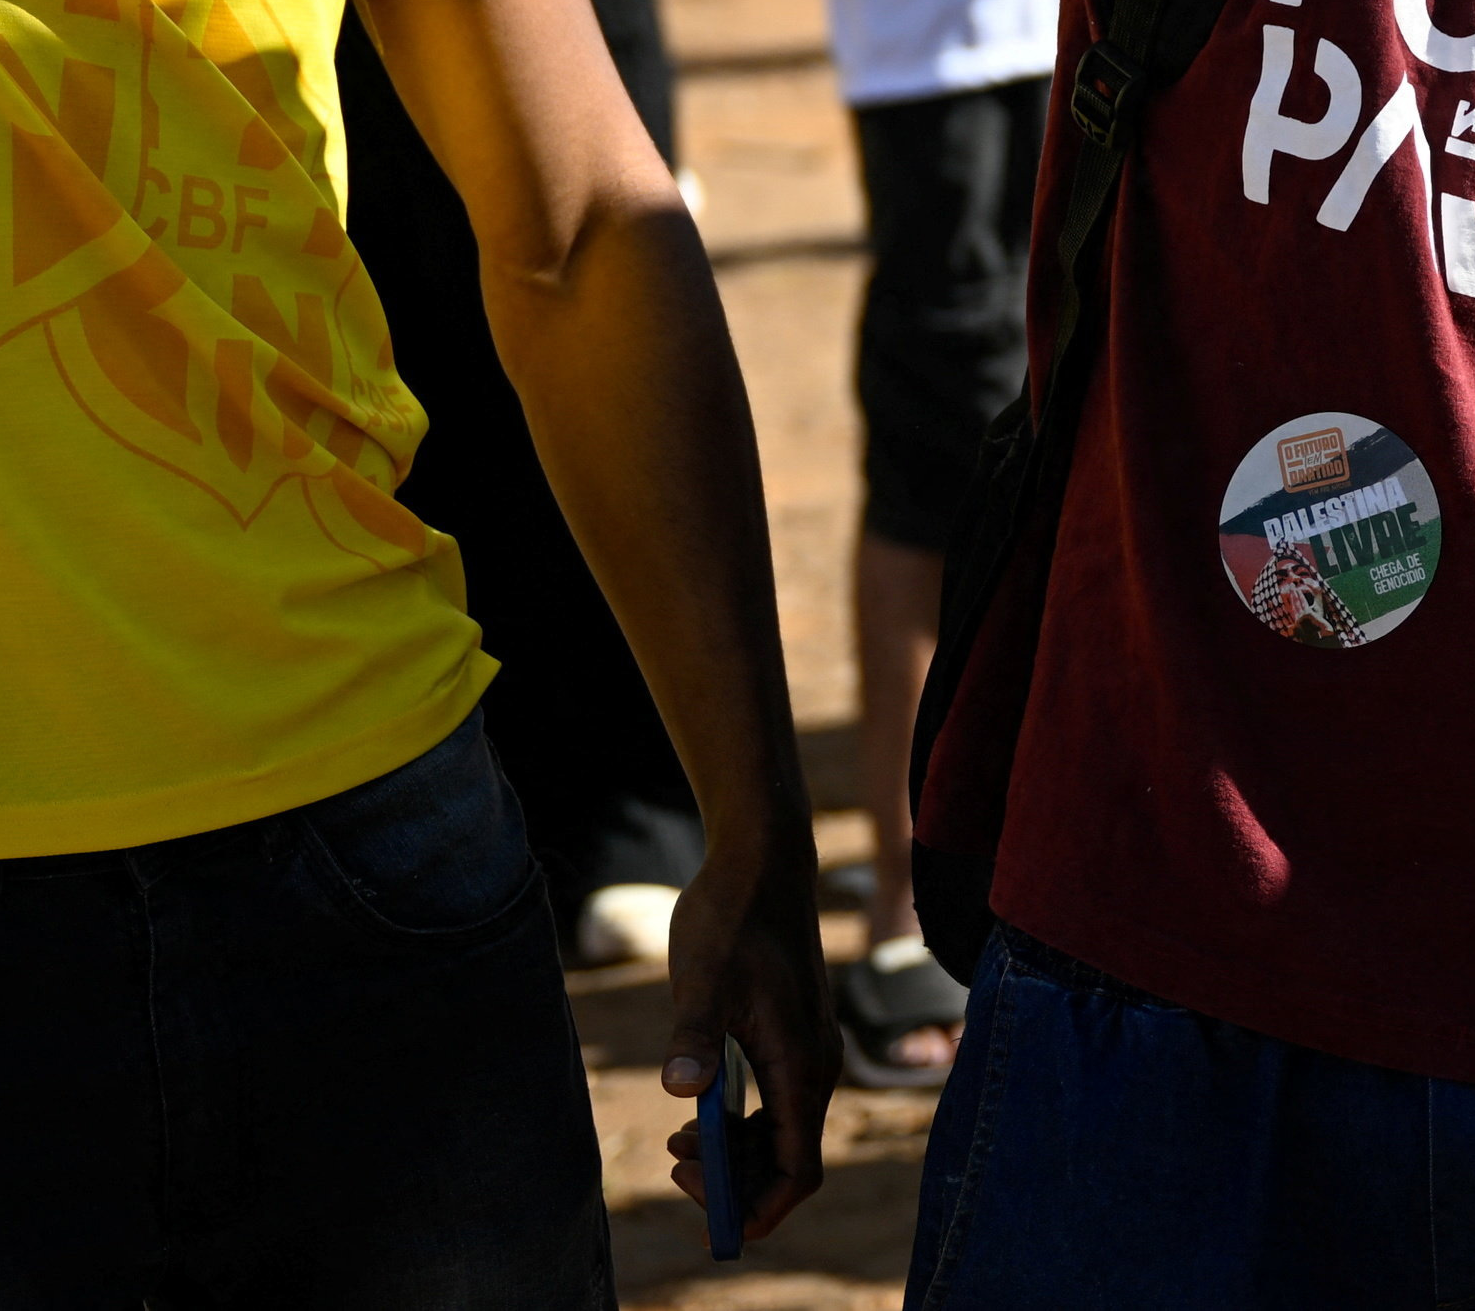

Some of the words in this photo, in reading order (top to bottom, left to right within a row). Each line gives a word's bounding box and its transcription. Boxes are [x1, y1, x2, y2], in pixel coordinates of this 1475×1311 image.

[1284, 445, 1294, 461] O
[1294, 434, 1339, 459] FUTURO
[1288, 459, 1345, 486] PARTIDO
[1263, 476, 1408, 551] PALESTINA
[1308, 501, 1427, 579] LIVRE
[1406, 552, 1423, 568] DE
[1374, 566, 1426, 595] GENOCIDIO
